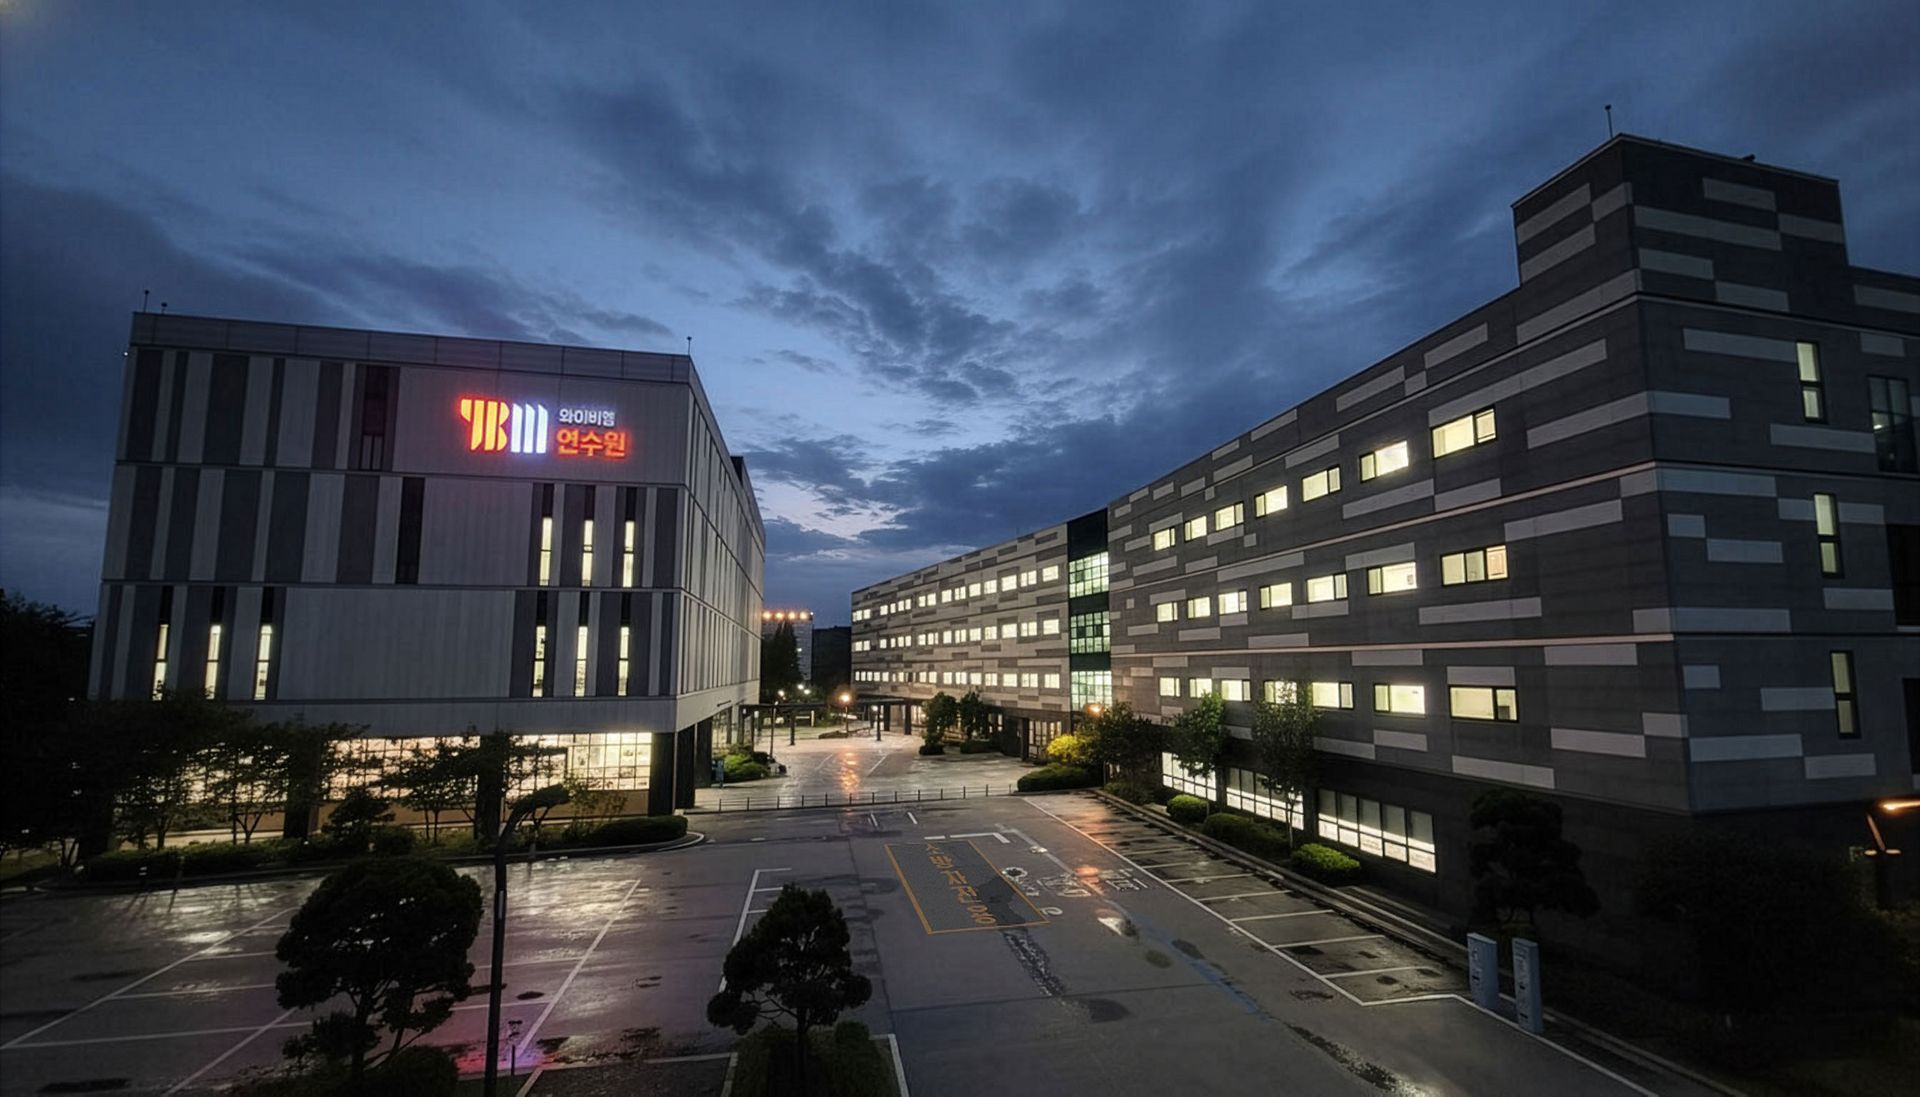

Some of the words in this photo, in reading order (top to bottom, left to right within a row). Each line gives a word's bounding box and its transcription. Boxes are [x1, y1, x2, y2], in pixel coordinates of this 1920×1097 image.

[459, 398, 549, 455] YBM
[558, 408, 616, 428] 와이비엠
[557, 428, 627, 458] 연수원
